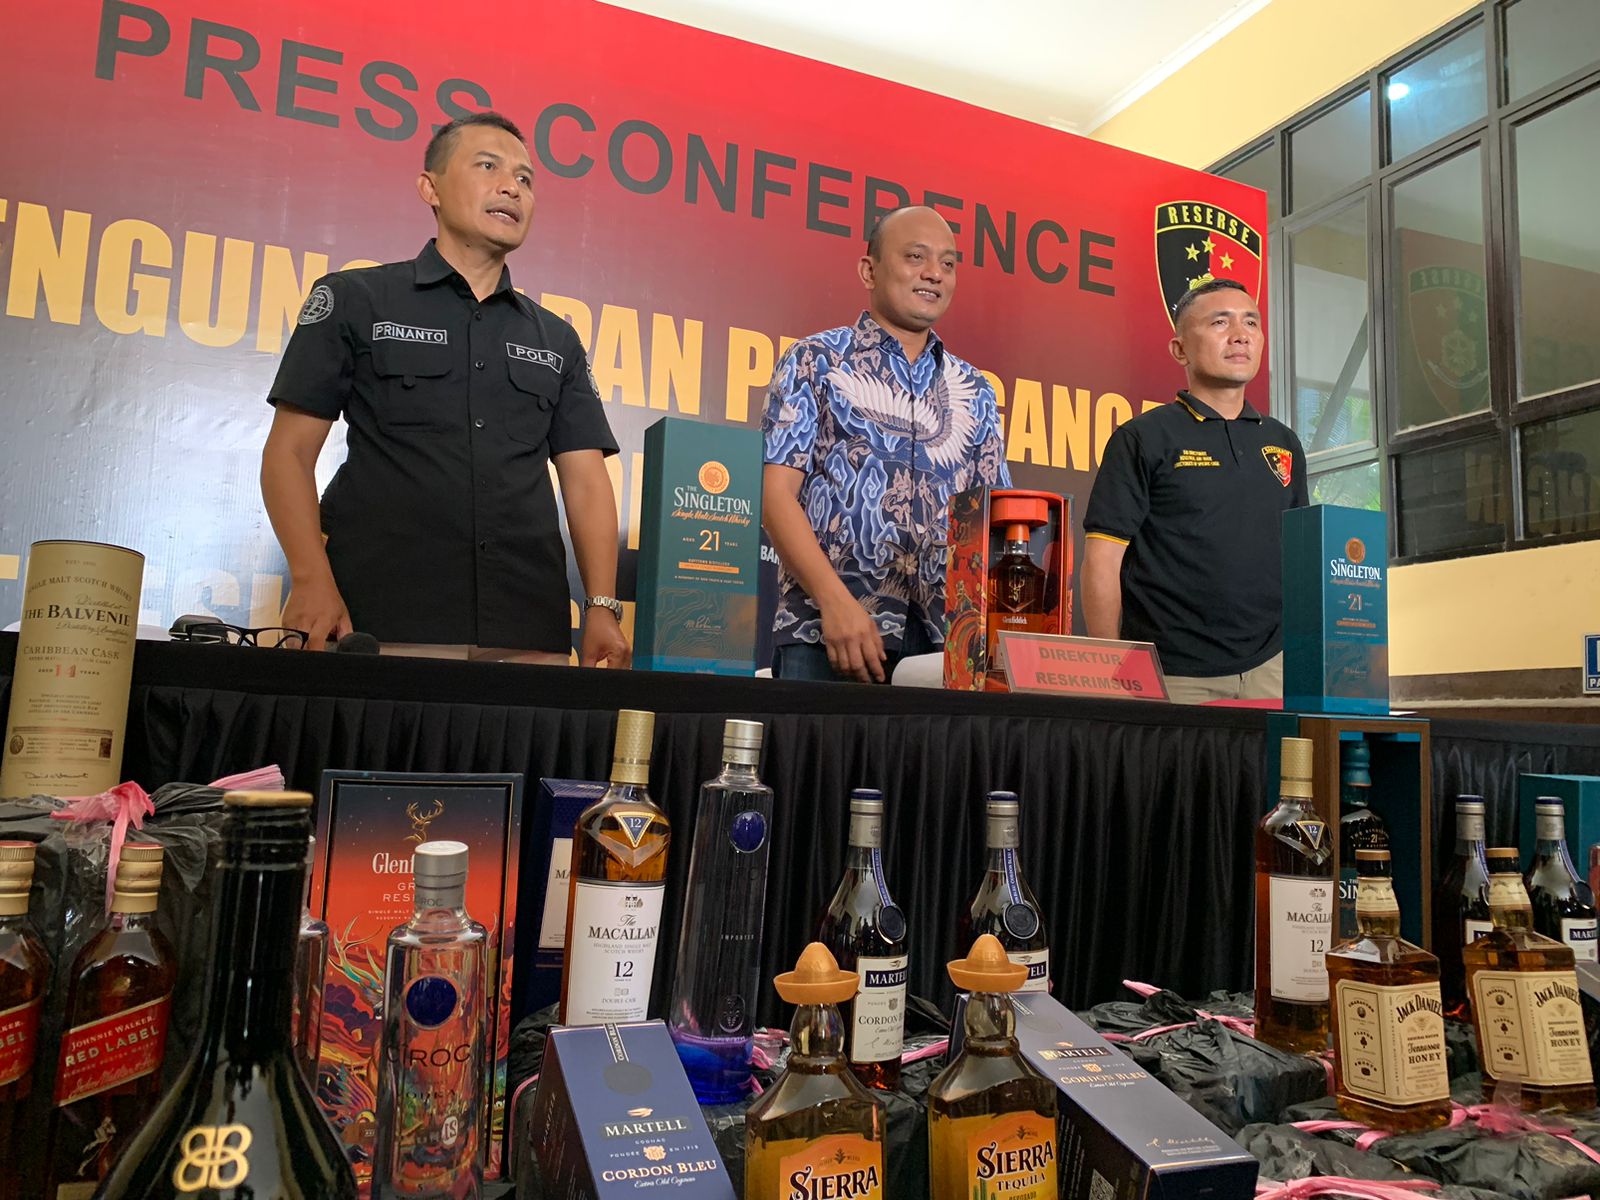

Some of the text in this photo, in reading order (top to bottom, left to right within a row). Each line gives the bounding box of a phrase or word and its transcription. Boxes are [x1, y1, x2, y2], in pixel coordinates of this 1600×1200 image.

[95, 0, 493, 141] PRESS
[1168, 205, 1250, 245] RESERSE
[375, 325, 444, 343] PRINANTO
[515, 346, 557, 367] POLRI
[699, 529, 720, 551] 21
[49, 575, 71, 584] MALT
[74, 576, 107, 588] SCOTCH
[1347, 593, 1363, 611] 21
[25, 608, 45, 620] THE
[23, 645, 89, 656] CARIBBEAN
[91, 647, 121, 660] CASK
[1038, 646, 1121, 666] DIREKTUR
[1035, 670, 1143, 692] RESKRIMSUS
[630, 818, 642, 828] 12
[1339, 880, 1358, 899] SIN
[620, 914, 637, 926] The
[588, 925, 657, 940] MACALLAN
[1310, 939, 1324, 953] 12
[615, 960, 634, 978] 12
[1534, 988, 1554, 1008] JACK
[858, 1015, 898, 1026] CORDON
[1396, 1000, 1416, 1024] JACK
[71, 1015, 154, 1052] JOHNNIE WALKER
[65, 1025, 159, 1067] RED LABEL
[1550, 1038, 1581, 1048] HONEY
[1408, 1052, 1442, 1065] HONEY
[1060, 1071, 1148, 1085] CORDON BLEU
[605, 1119, 687, 1137] MARTELL
[976, 1140, 1055, 1180] SIERRA
[602, 1159, 718, 1182] CORDON BLEU
[789, 1165, 880, 1200] SIERRA
[997, 1172, 1047, 1192] TEQUILA
